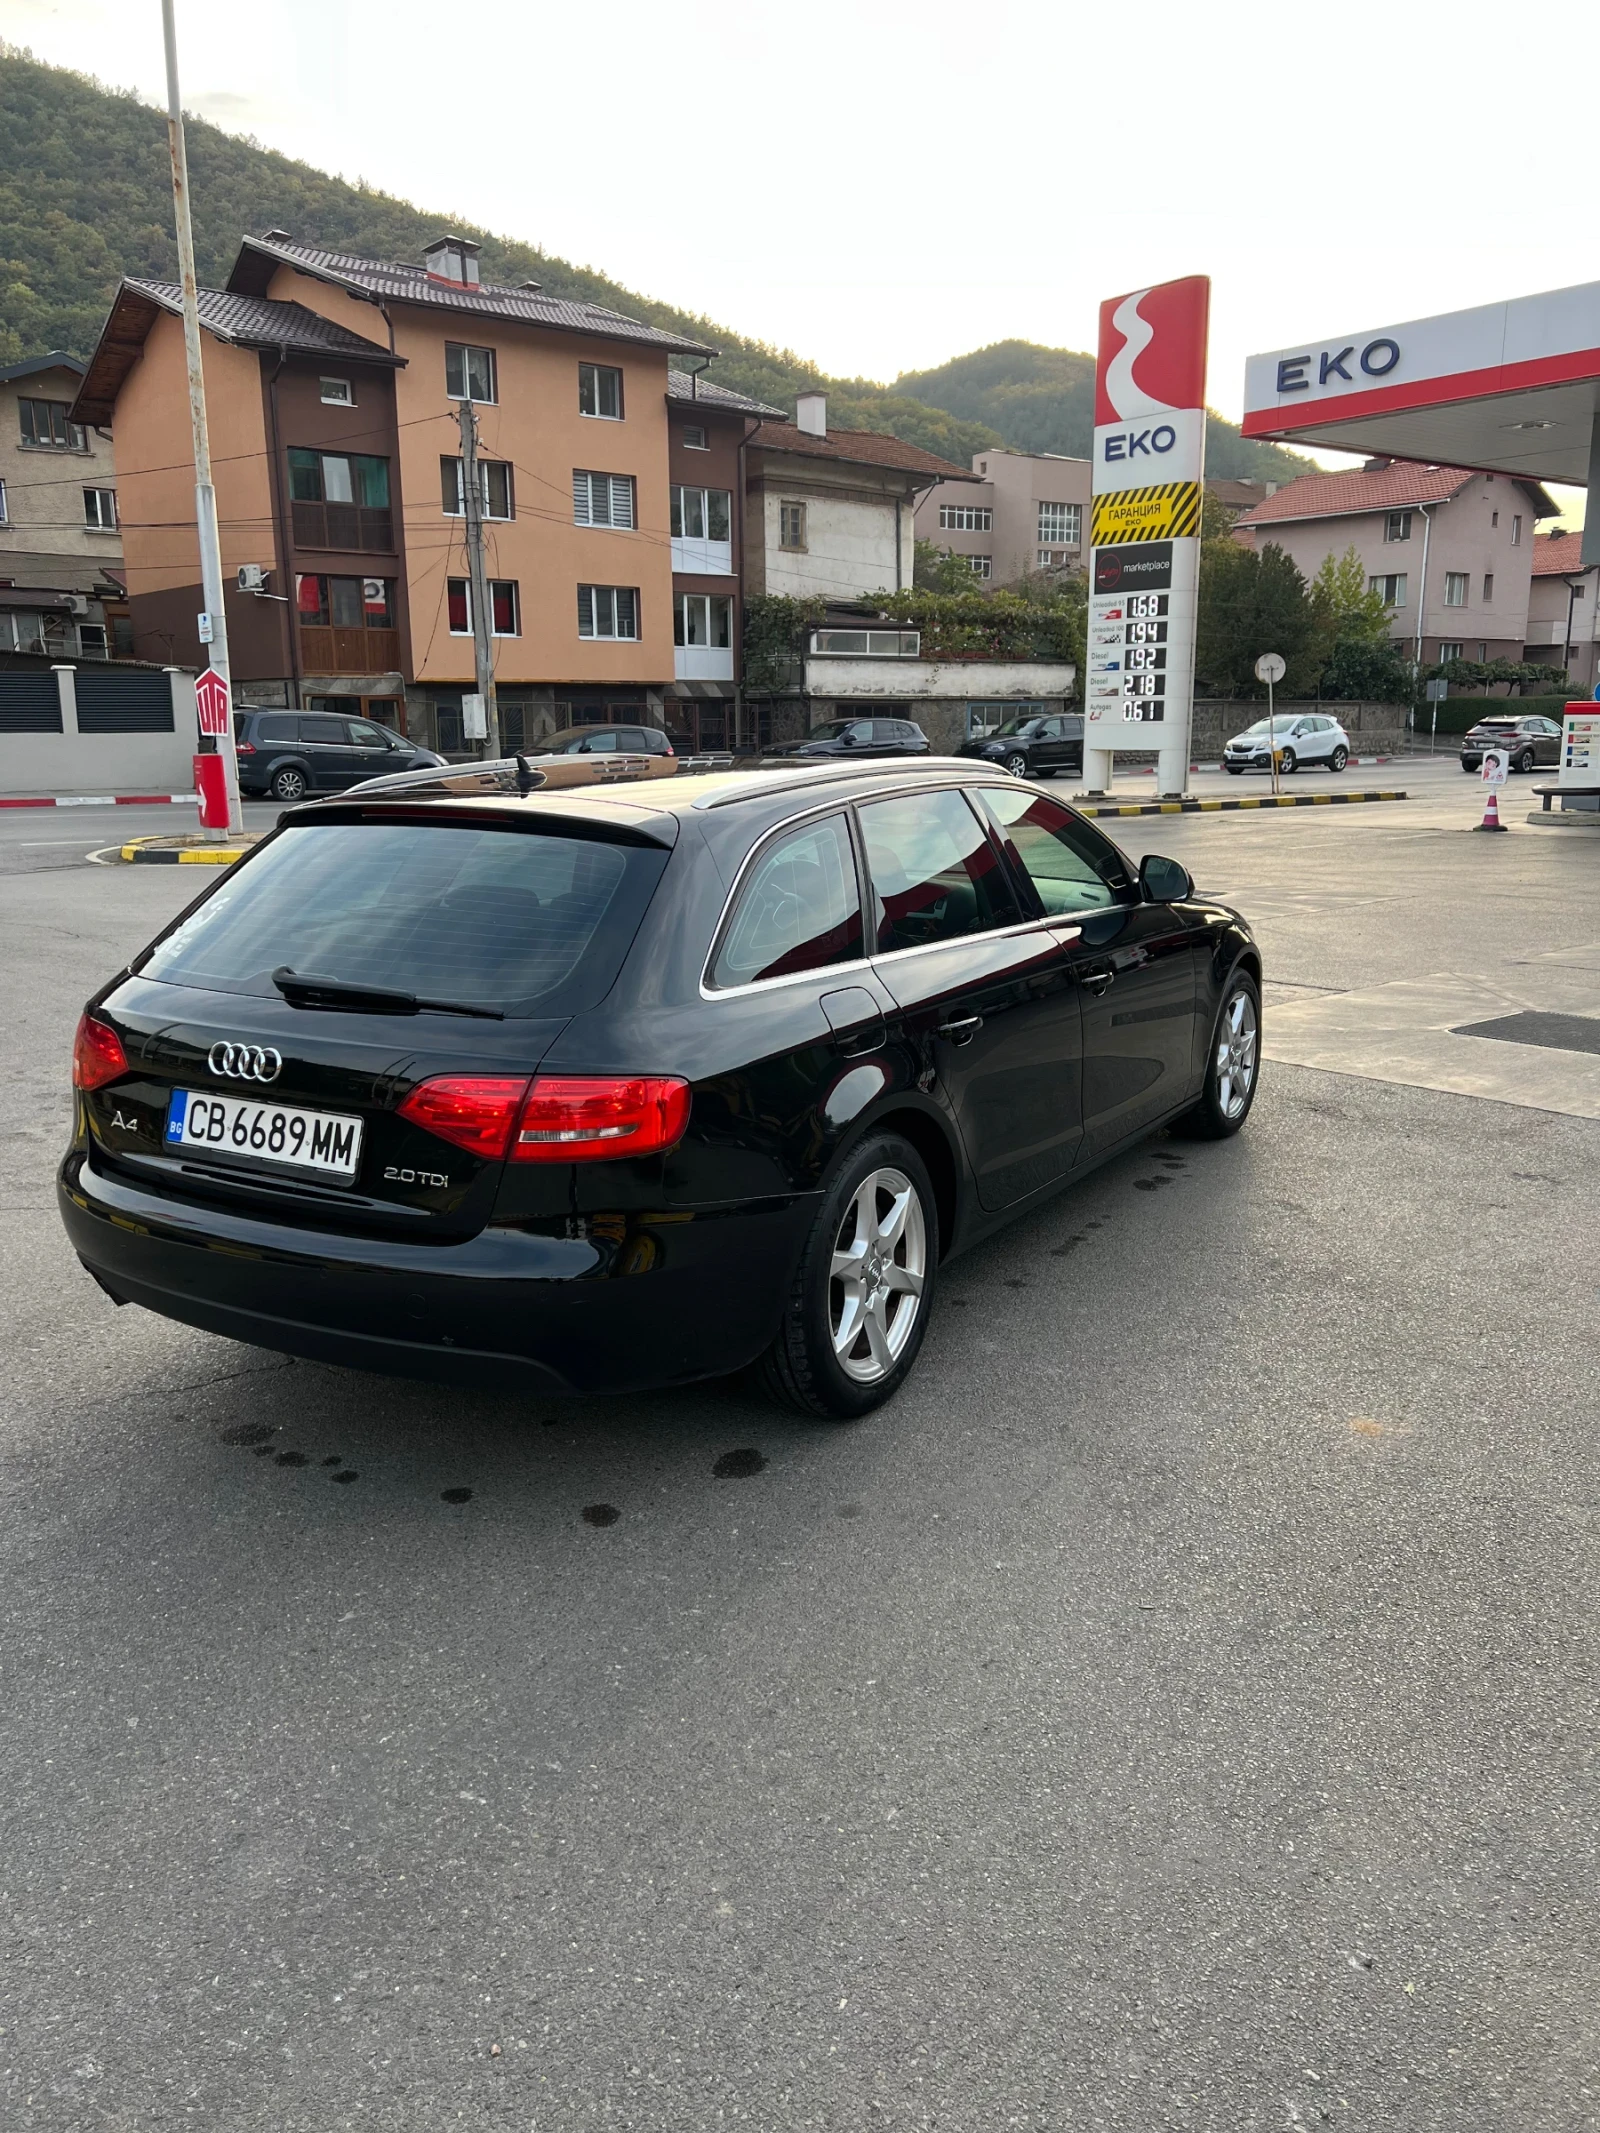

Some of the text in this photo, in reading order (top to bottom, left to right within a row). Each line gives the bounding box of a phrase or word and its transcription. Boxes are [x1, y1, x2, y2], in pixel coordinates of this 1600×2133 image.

[1276, 338, 1400, 392] EKO
[1104, 425, 1176, 462] EKO
[1108, 503, 1161, 520] ГАРАНЦИЯ
[1123, 560, 1170, 573] marketplace
[1132, 595, 1158, 618] 1.68
[1131, 622, 1158, 644] 1.94
[1130, 648, 1157, 670] 1.92
[1124, 675, 1155, 696] 2.18
[1122, 701, 1155, 721] 0.61
[110, 1110, 138, 1133] A4
[169, 1121, 182, 1134] BG
